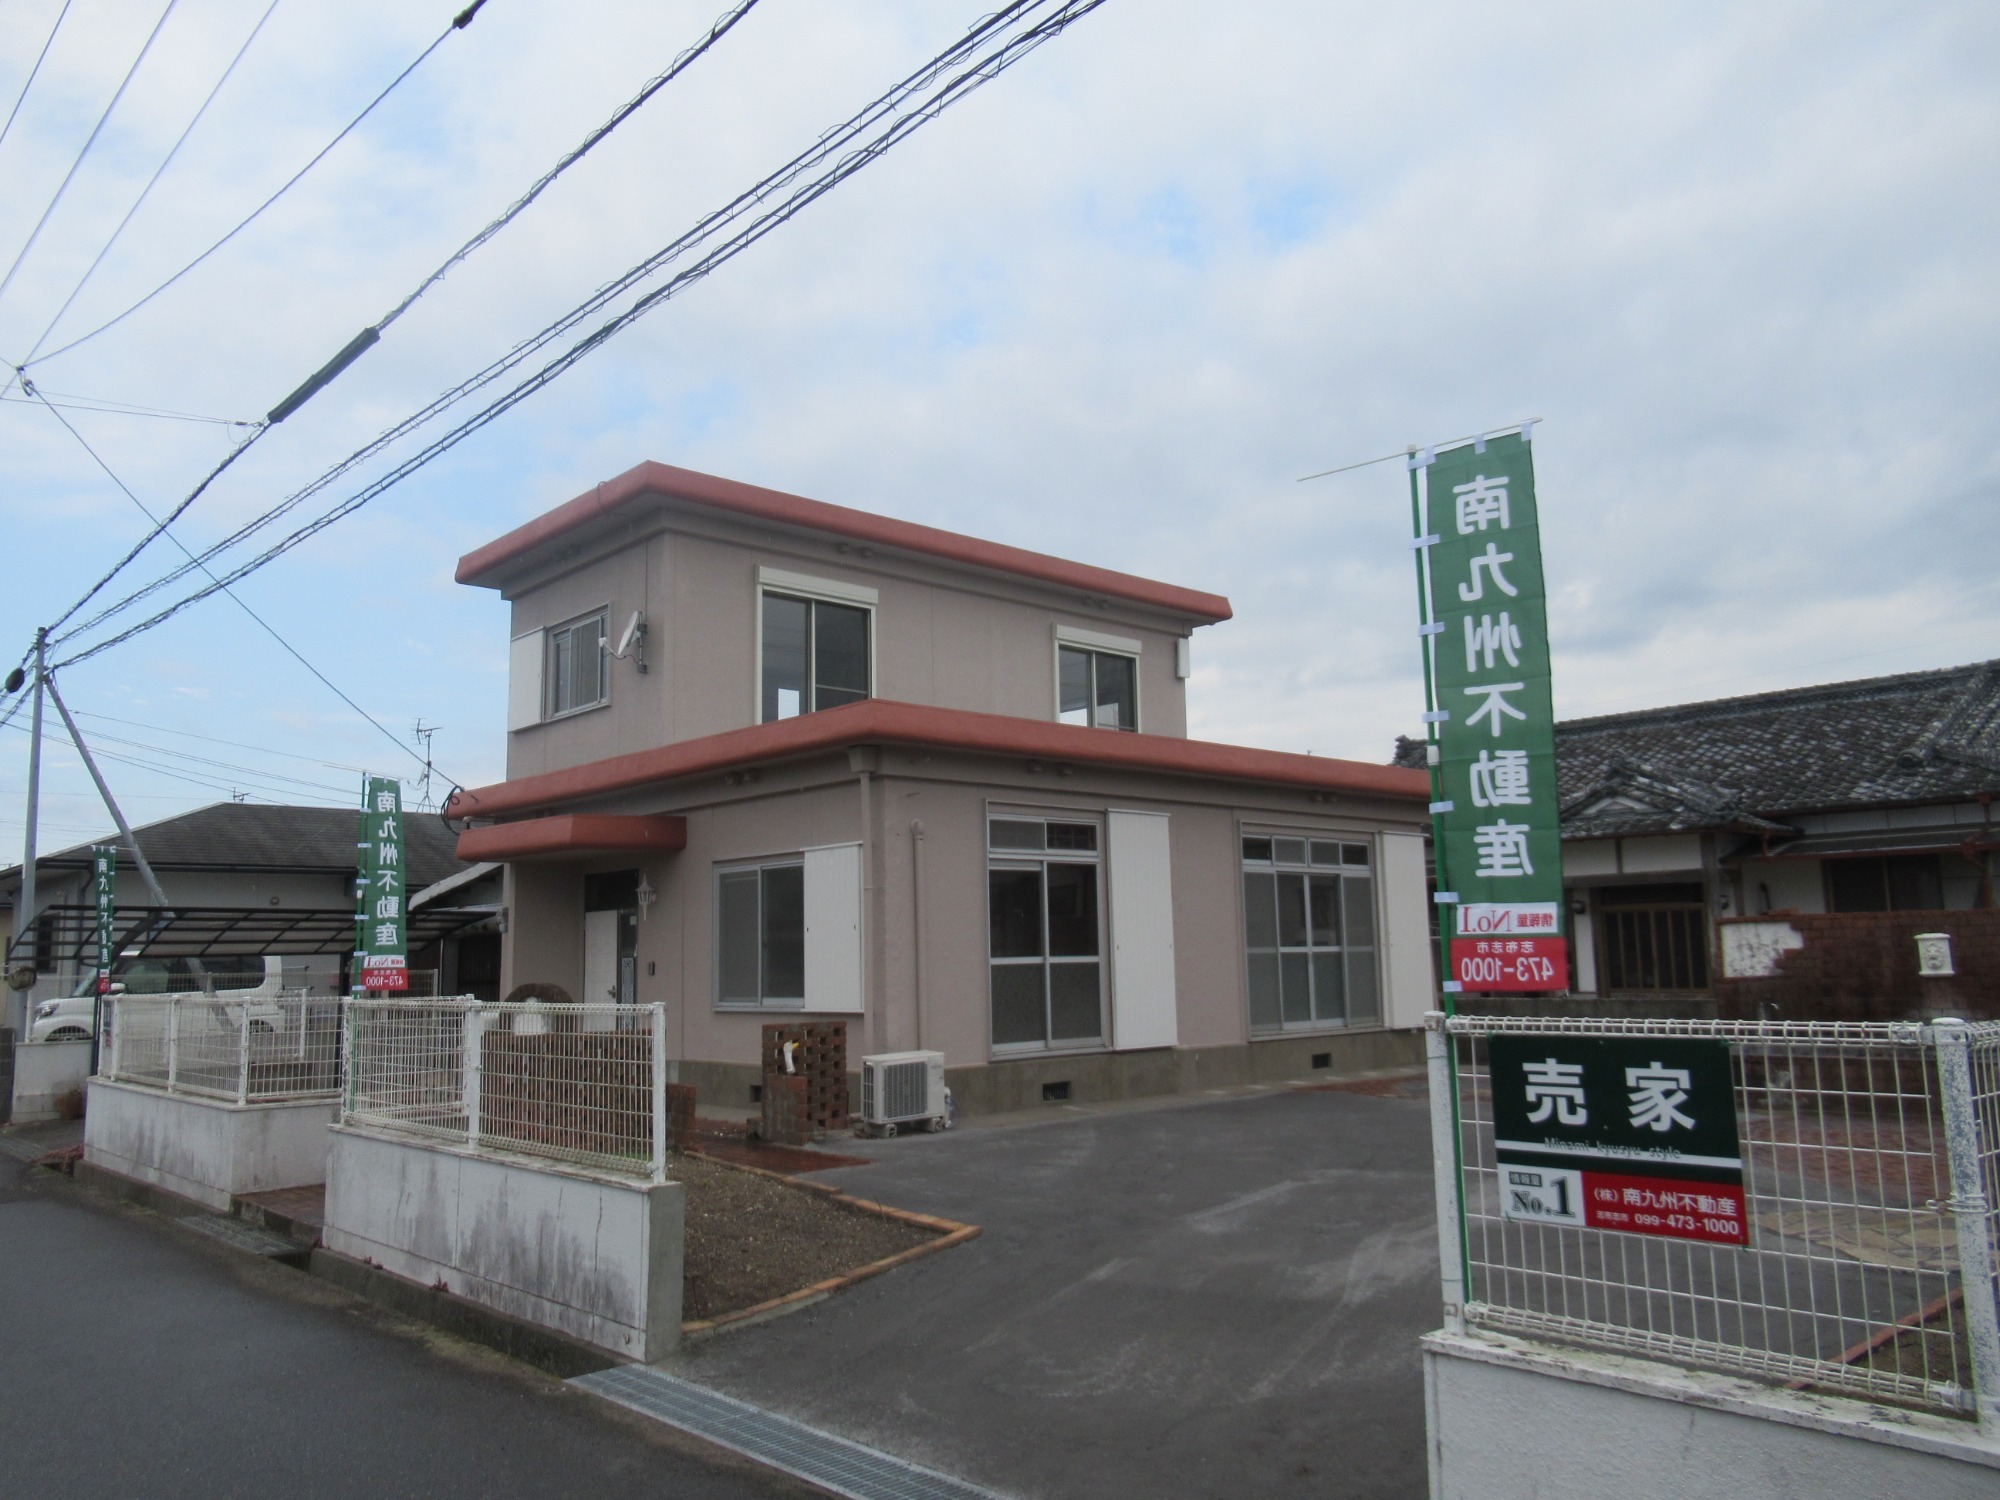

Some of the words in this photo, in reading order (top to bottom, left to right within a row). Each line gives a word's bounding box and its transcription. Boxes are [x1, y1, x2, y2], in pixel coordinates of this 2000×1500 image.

[1544, 1137, 1590, 1152] Minami
[1596, 1140, 1642, 1157] kyusyu
[1649, 1145, 1682, 1159] style
[1510, 1176, 1575, 1218] No.1
[1622, 1188, 1737, 1217] 南九州不動産
[1634, 1213, 1740, 1235] 099-473-1000
